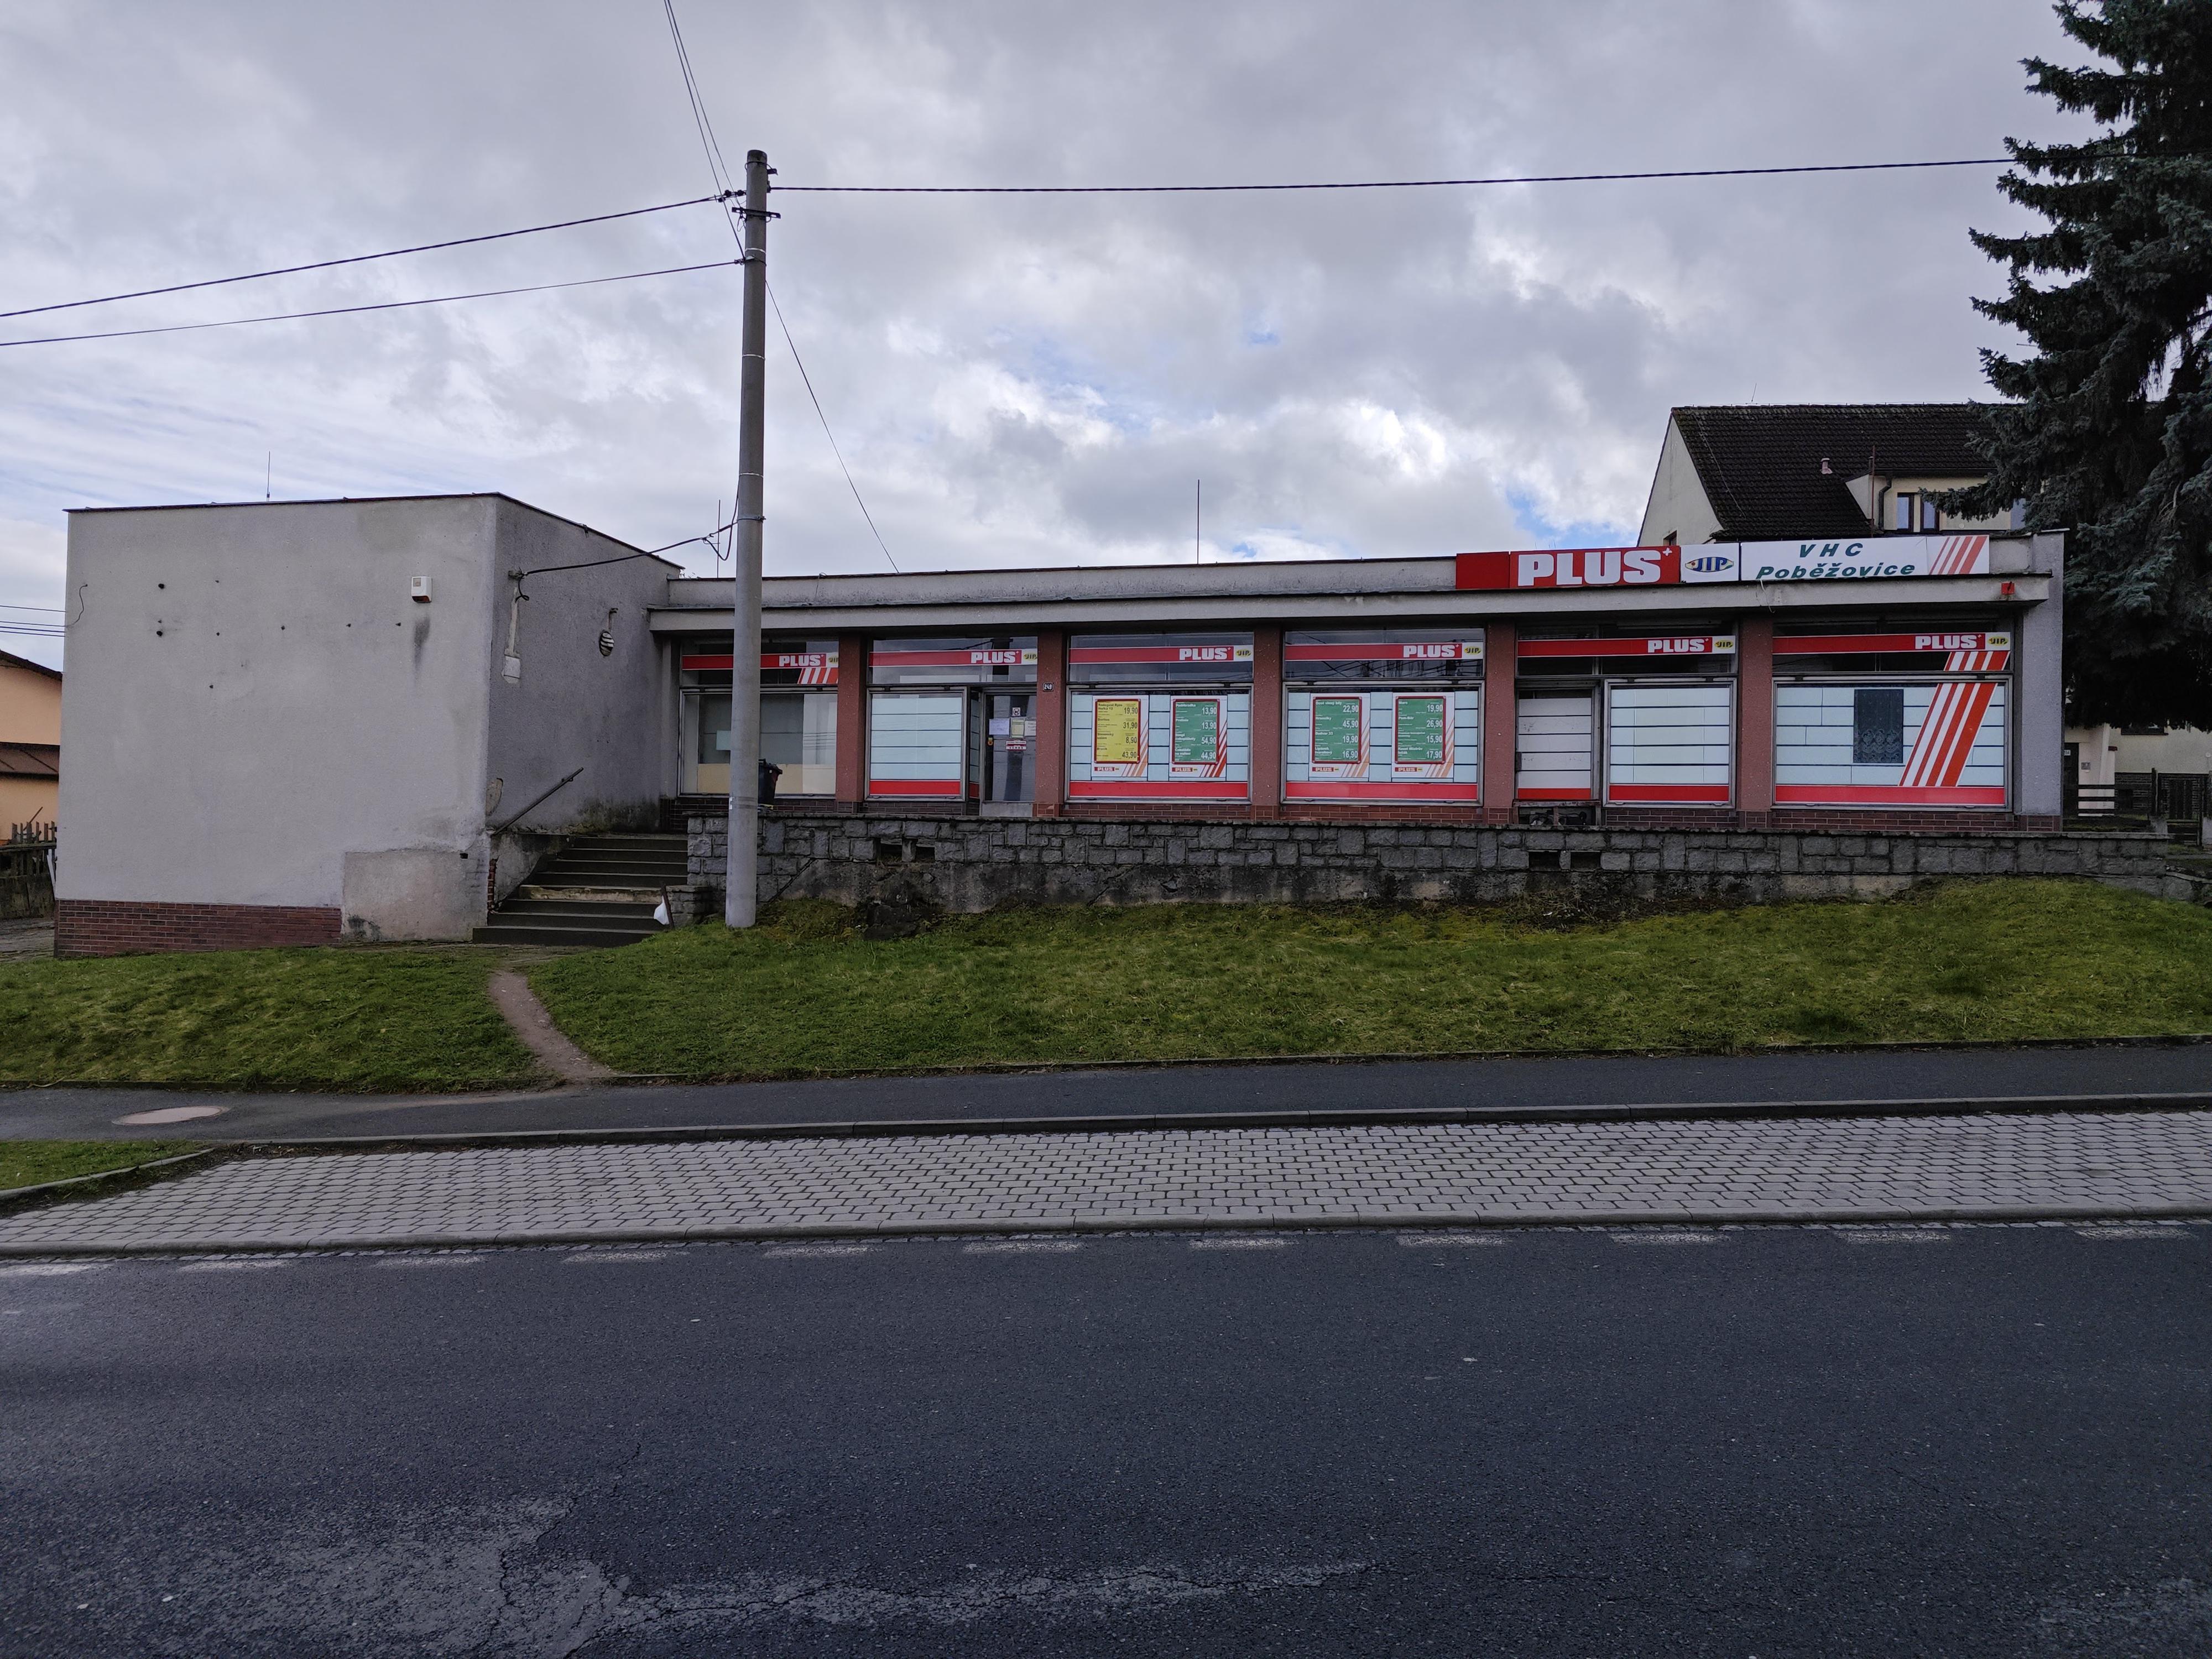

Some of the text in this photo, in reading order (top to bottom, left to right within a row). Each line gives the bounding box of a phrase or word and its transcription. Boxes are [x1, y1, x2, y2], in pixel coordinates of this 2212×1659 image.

[1799, 542, 1863, 558] VHC
[1756, 562, 1915, 580] Poběžovice
[1124, 707, 1138, 716] 19,90
[1202, 707, 1217, 716] 13,90
[1343, 705, 1359, 713] 22,90
[1427, 705, 1443, 713] 19,90
[1202, 722, 1217, 730] 13,90
[1342, 720, 1359, 729] 45,90
[1427, 720, 1443, 728] 26,90
[1201, 737, 1216, 745] 54,90
[1343, 735, 1358, 744] 19,90
[1426, 735, 1442, 743] 15,90
[1342, 750, 1358, 759] 16,90
[1426, 750, 1442, 759] 17,90
